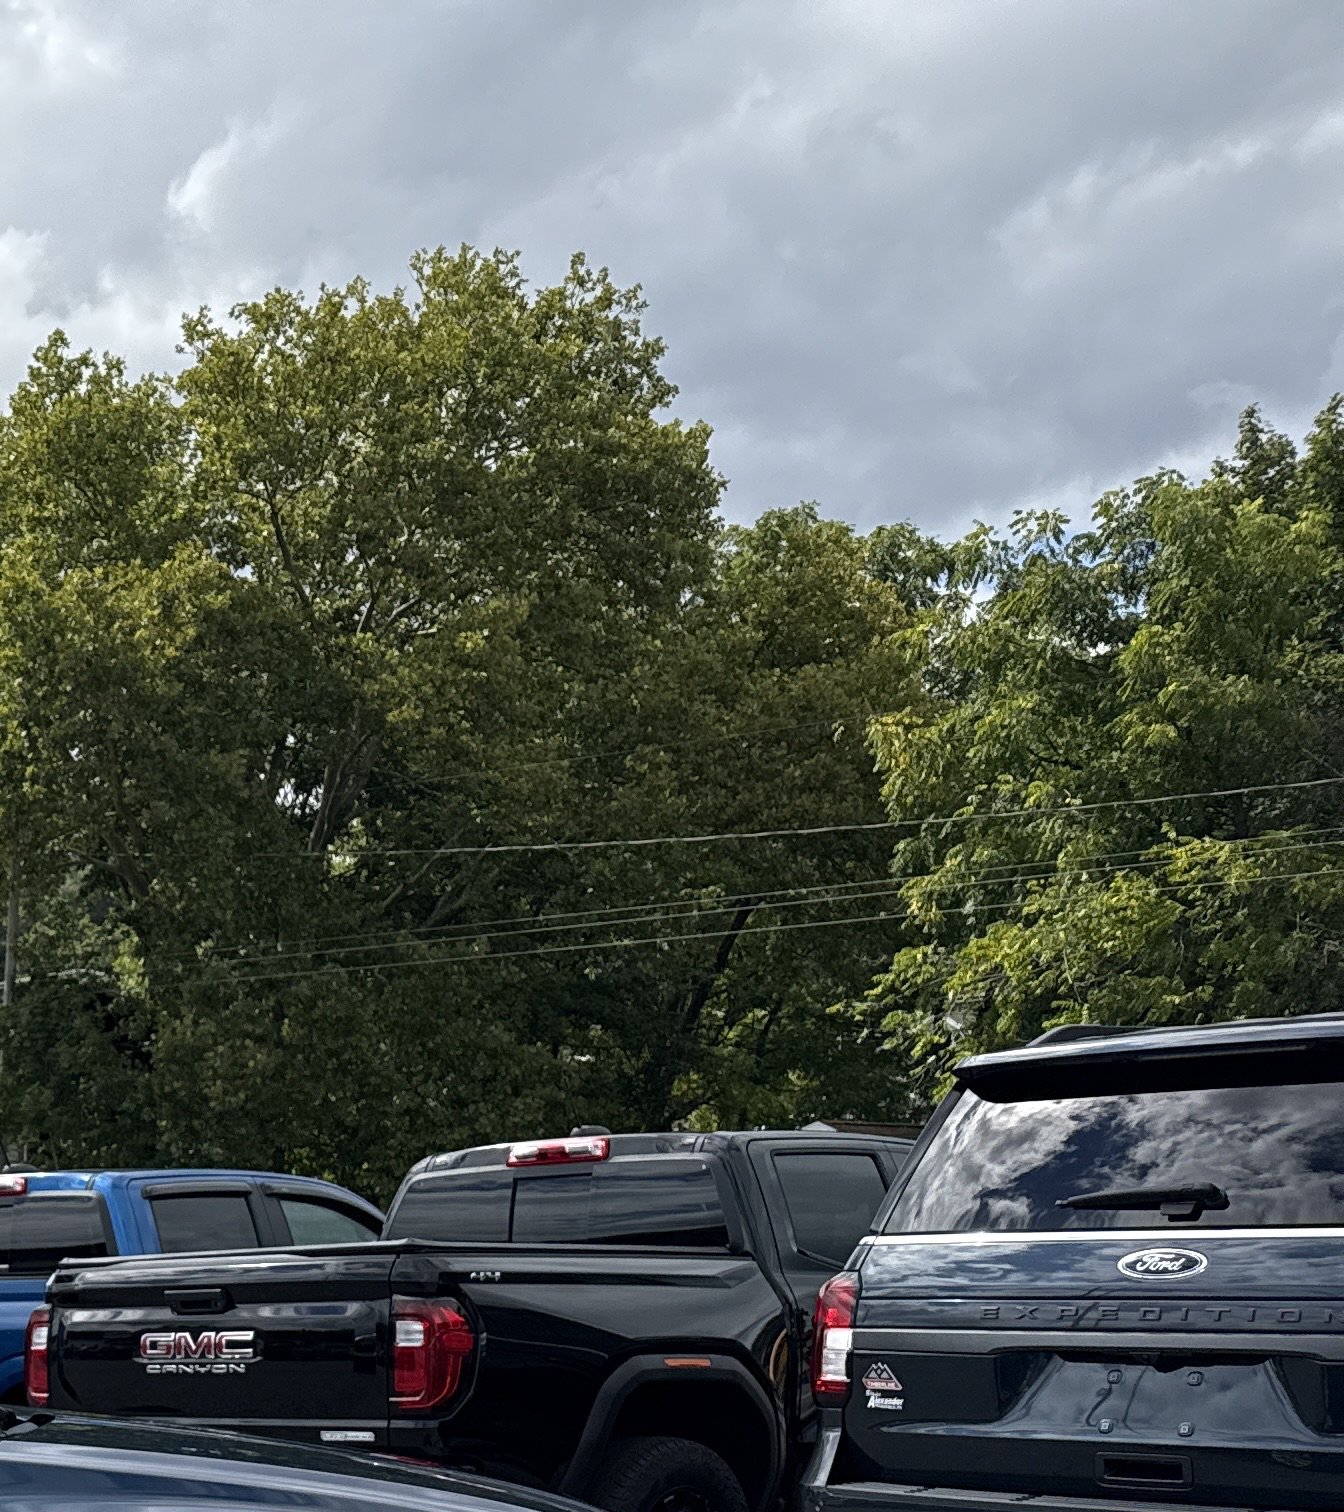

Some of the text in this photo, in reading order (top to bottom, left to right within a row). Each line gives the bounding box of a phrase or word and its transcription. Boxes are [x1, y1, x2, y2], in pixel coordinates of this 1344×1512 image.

[1136, 1253, 1186, 1272] Ford
[140, 1331, 254, 1359] GMC
[146, 1364, 246, 1374] CANYON
